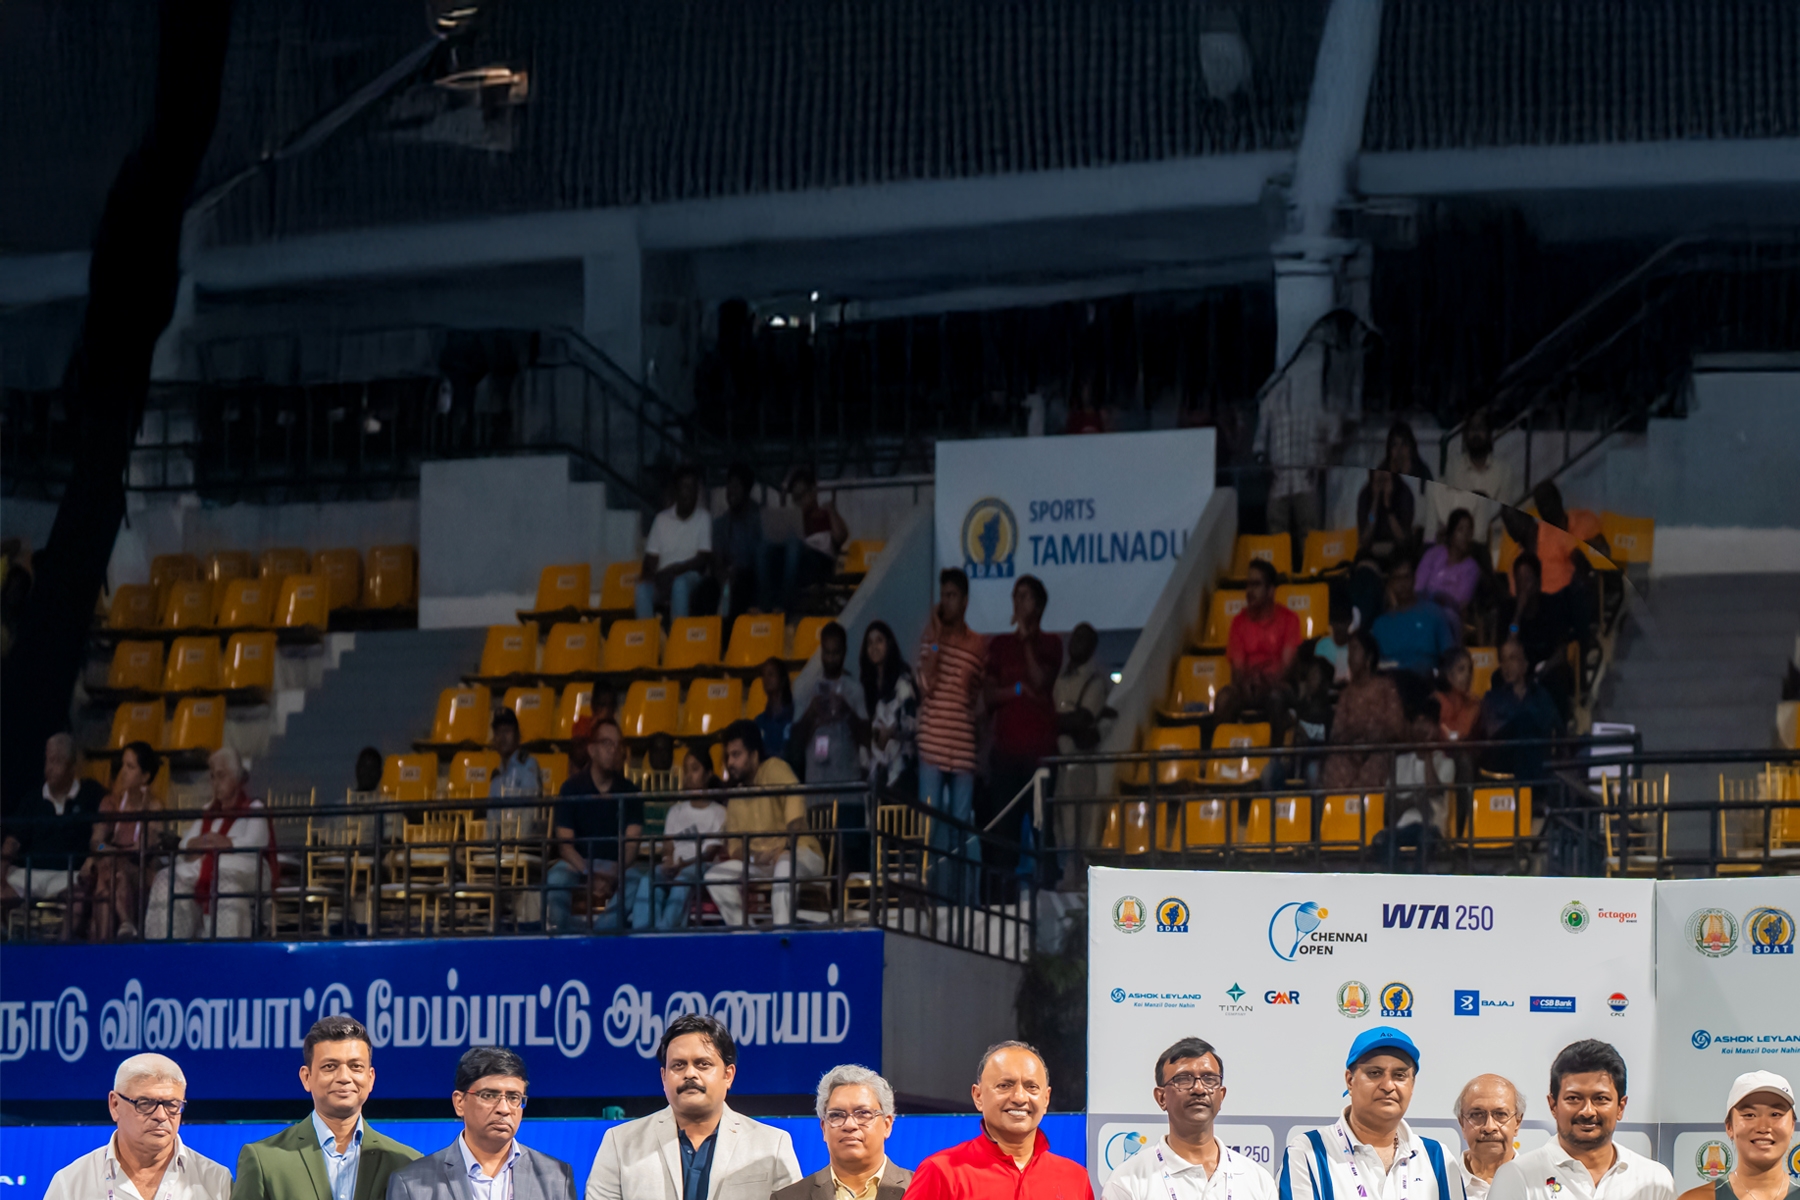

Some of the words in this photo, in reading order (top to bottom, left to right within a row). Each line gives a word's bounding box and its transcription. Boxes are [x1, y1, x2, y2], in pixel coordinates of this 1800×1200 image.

[1029, 499, 1096, 523] SPORTS
[1029, 530, 1188, 566] TAMILNADU
[1382, 903, 1449, 930] WTA
[1455, 905, 1494, 930] 250
[1598, 911, 1636, 923] octagon
[1310, 932, 1368, 942] CHENNAI
[1298, 945, 1333, 955] OPEN
[1755, 945, 1790, 953] SDAT
[1264, 990, 1300, 1005] GMR
[1540, 999, 1554, 1007] CSB
[1554, 999, 1572, 1008] Bank
[366, 968, 591, 1058] மேம்பாட்டு
[1714, 1034, 1754, 1043] ASHOK
